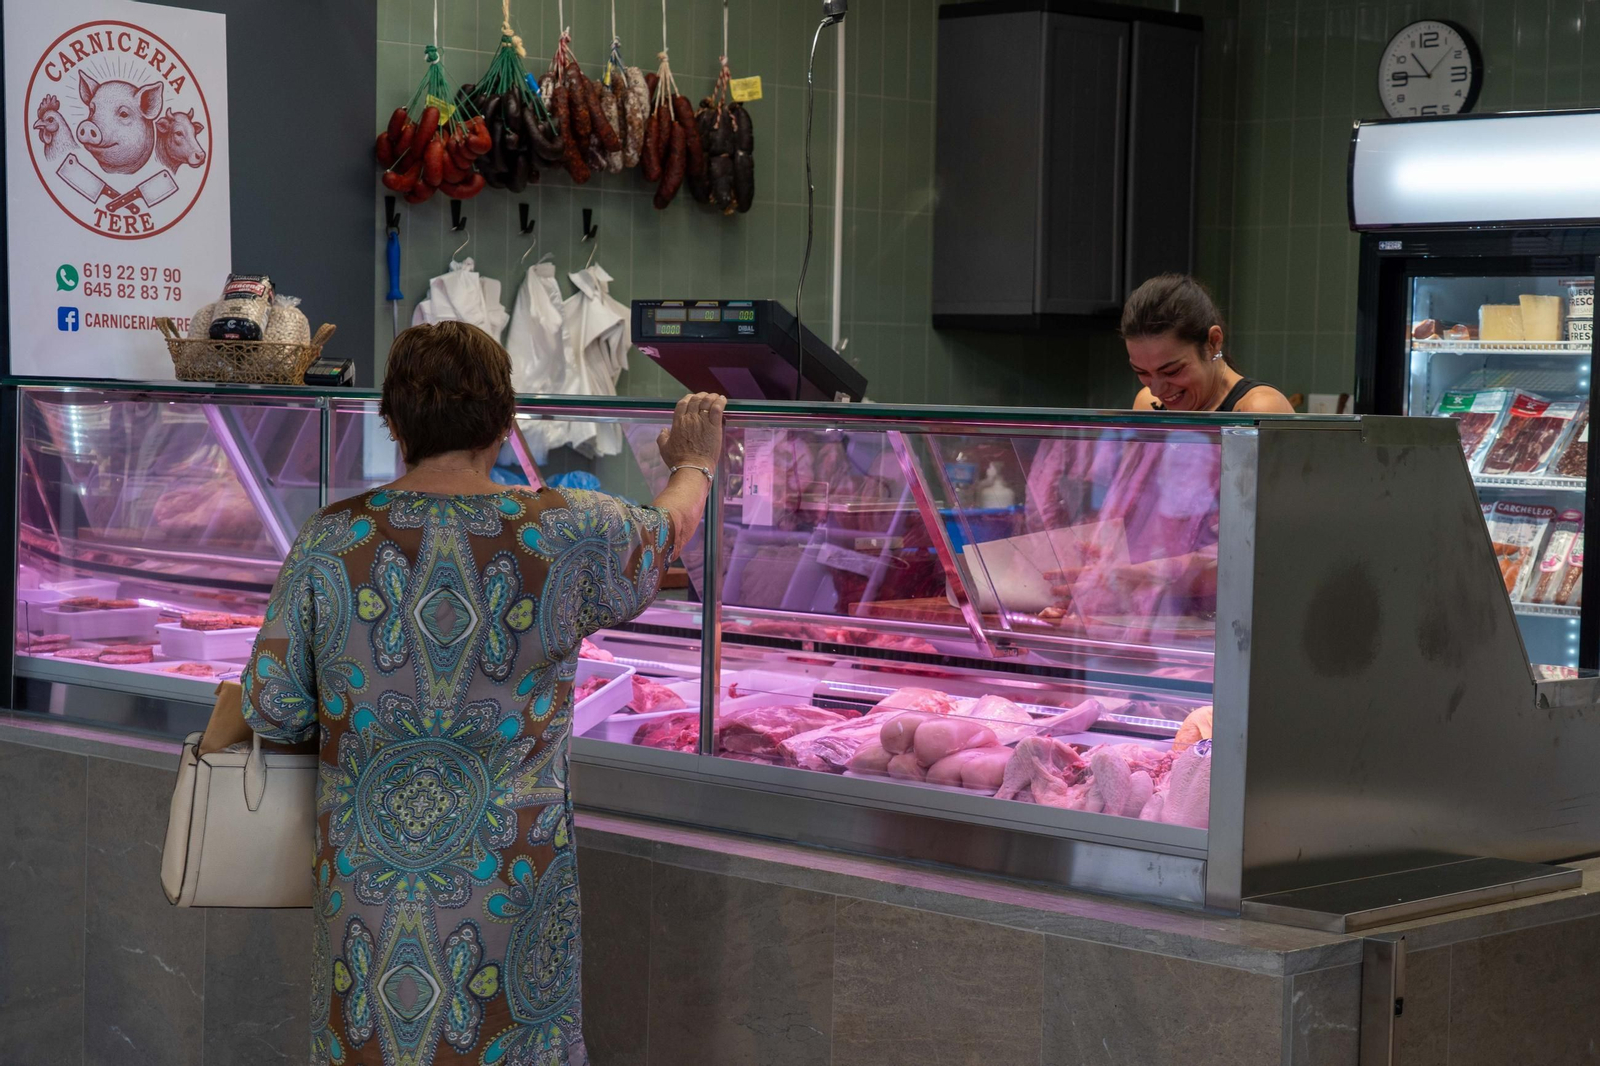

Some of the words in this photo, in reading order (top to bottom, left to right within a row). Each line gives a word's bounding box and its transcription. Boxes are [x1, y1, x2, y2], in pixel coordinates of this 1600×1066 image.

[1420, 32, 1439, 48] 12
[1396, 55, 1407, 65] 10
[1454, 50, 1462, 59] 2
[44, 30, 187, 95] CARNICERIA
[1392, 71, 1408, 87] 9
[1451, 66, 1467, 83] 3
[1397, 94, 1405, 103] 8
[1454, 89, 1462, 98] 4
[94, 208, 155, 234] TERE
[83, 263, 112, 279] 619
[117, 265, 135, 281] 22
[140, 266, 158, 282] 97
[163, 268, 181, 284] 90
[83, 281, 112, 298] 645
[117, 283, 136, 299] 82
[140, 285, 159, 301] 83
[163, 286, 182, 302] 79
[1569, 297, 1595, 306] FRESC
[84, 312, 159, 331] CARNICERIA
[1572, 323, 1594, 331] QUES
[1570, 332, 1593, 341] FRES
[1497, 503, 1553, 516] CARCHELEJO
